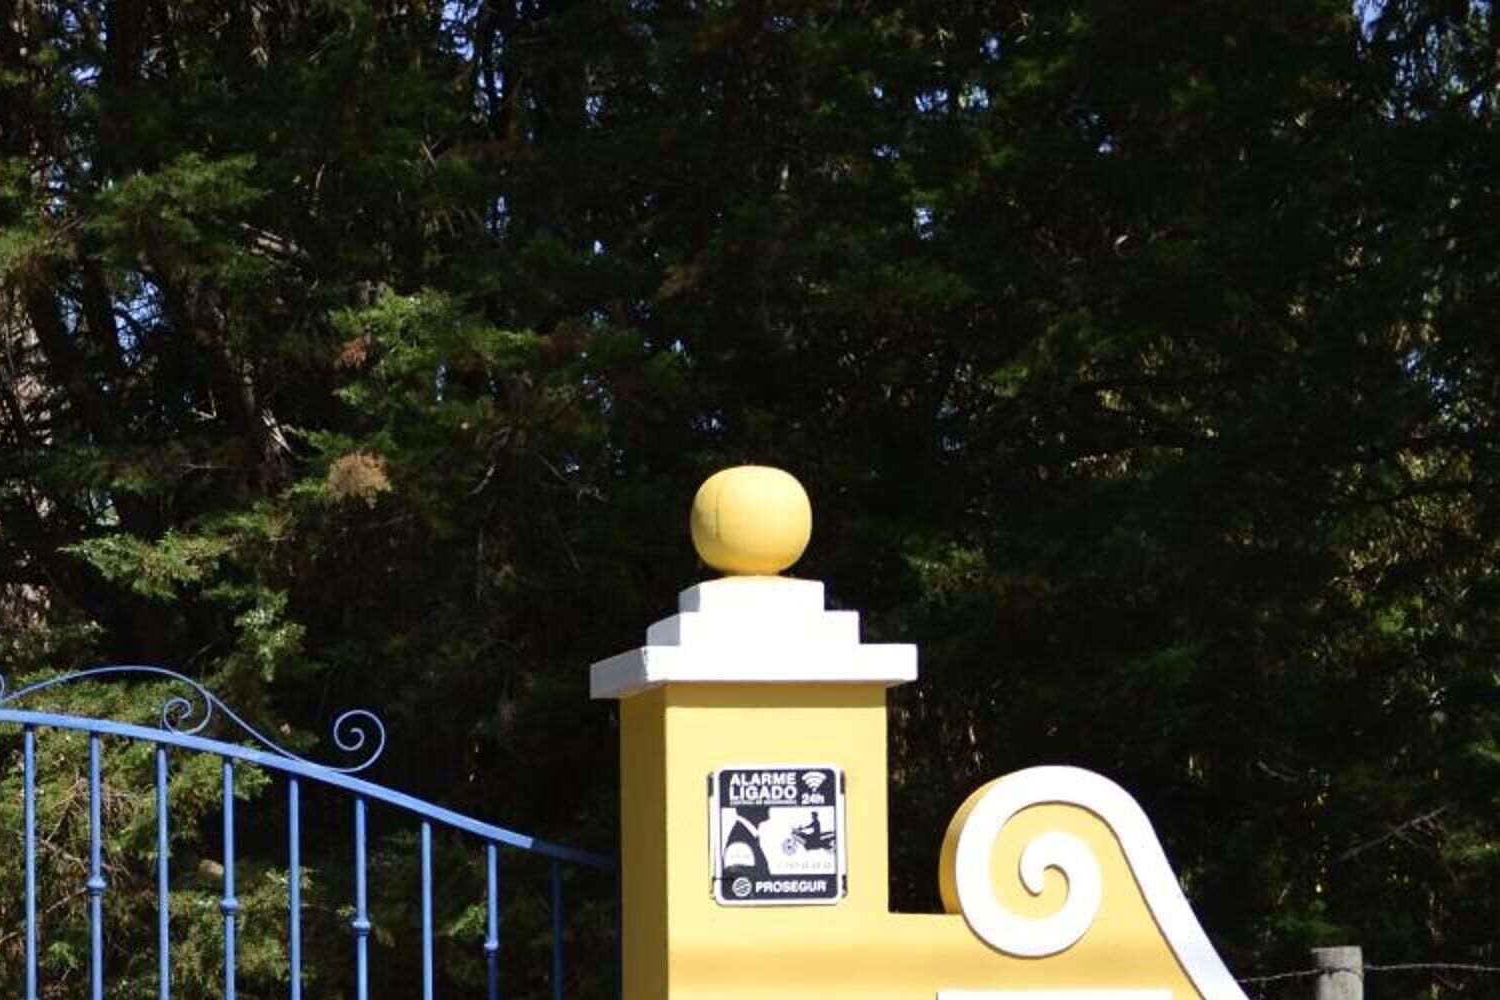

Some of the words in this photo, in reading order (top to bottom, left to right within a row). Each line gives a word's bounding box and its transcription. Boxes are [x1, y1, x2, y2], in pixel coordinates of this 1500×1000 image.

[729, 772, 797, 786] ALARME
[728, 785, 798, 800] LIGADO
[801, 793, 826, 805] 24h
[755, 880, 828, 893] PROSEGUR
